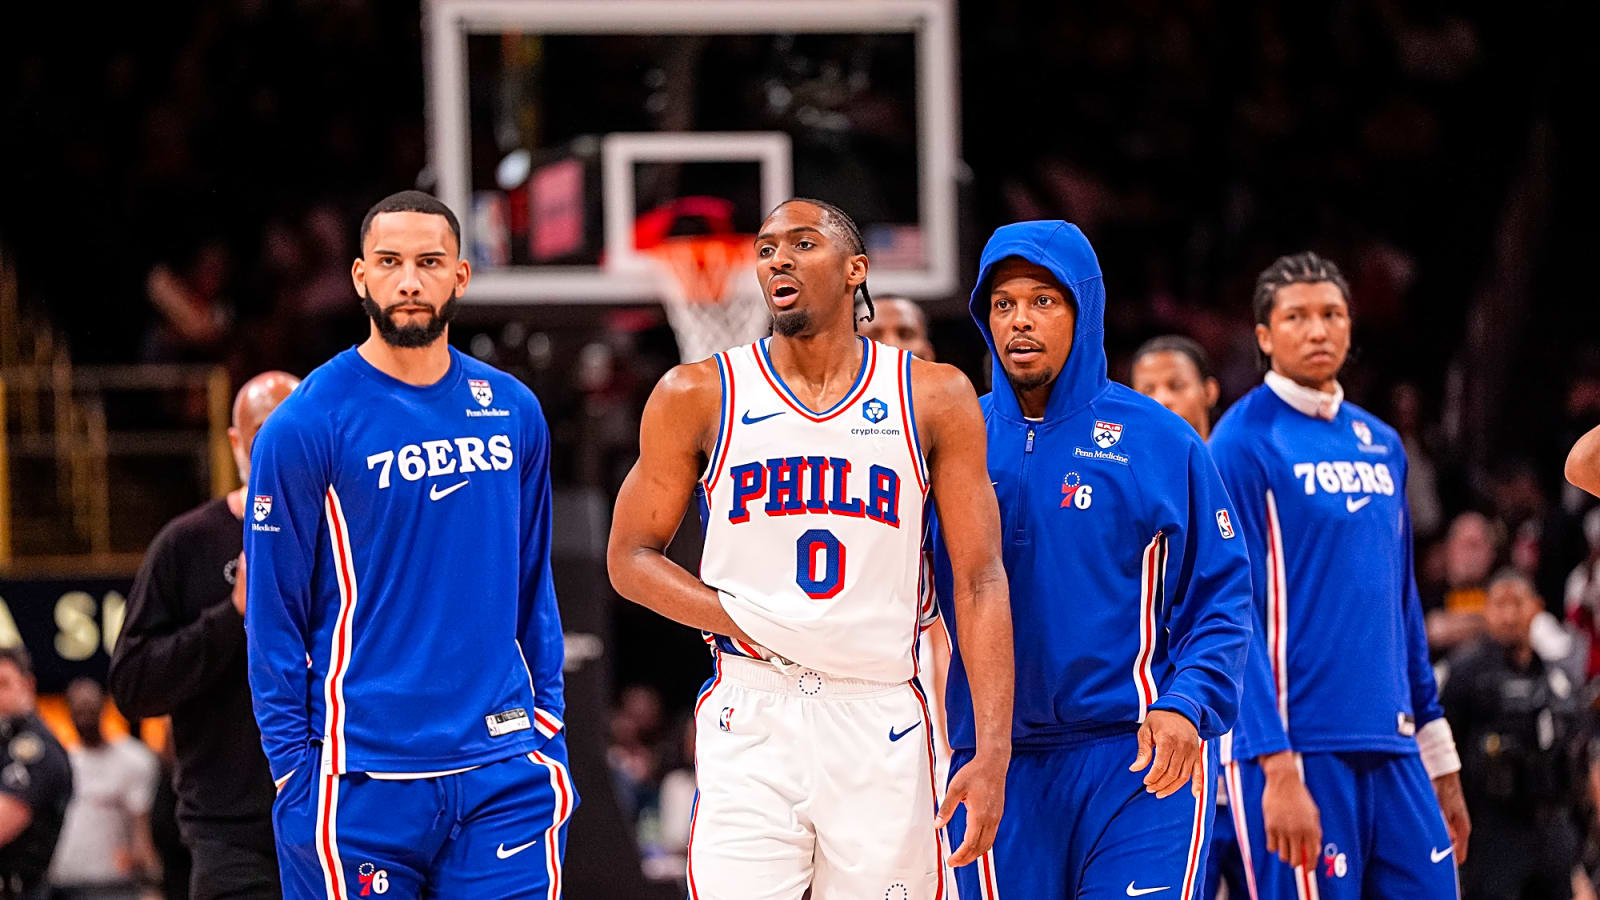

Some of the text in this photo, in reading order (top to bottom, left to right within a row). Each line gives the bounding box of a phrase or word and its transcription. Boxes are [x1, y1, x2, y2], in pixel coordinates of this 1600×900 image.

[466, 408, 510, 417] Penn Medicine
[850, 428, 900, 436] crypto.com
[366, 434, 514, 490] 76ERS
[1075, 447, 1129, 464] Penn Medicine
[728, 455, 901, 529] PHILA
[1293, 460, 1395, 497] 76ERS
[1060, 483, 1093, 510] 76
[796, 529, 846, 599] 0
[358, 869, 389, 896] 76
